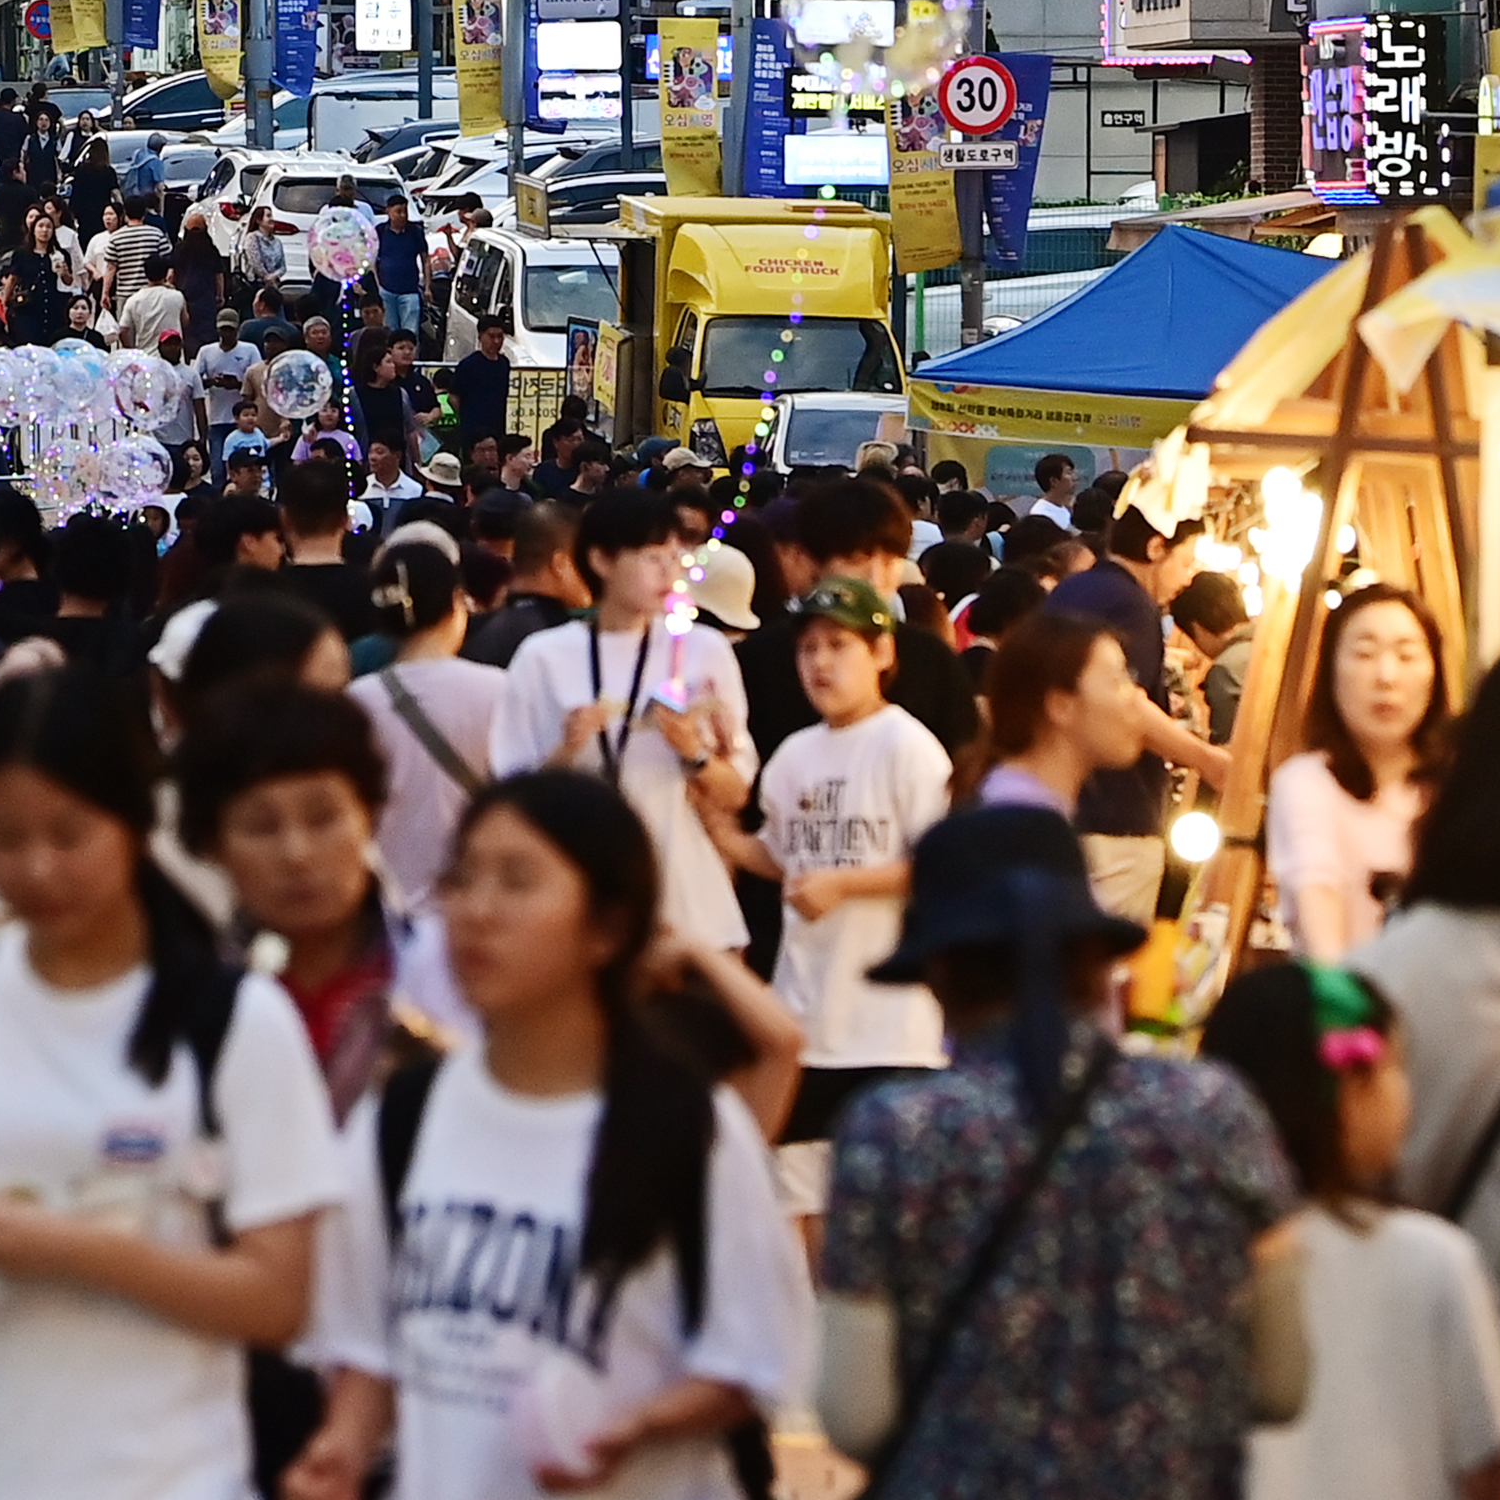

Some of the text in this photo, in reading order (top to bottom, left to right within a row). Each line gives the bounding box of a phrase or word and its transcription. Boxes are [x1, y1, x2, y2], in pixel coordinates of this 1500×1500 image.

[956, 77, 998, 113] 30
[1376, 29, 1428, 178] 노래방
[1103, 112, 1145, 126] 흡연구역
[942, 147, 1014, 163] 생활도로구역
[892, 157, 939, 174] 오십시
[744, 265, 840, 276] FOOD TRUCK
[758, 258, 824, 268] CHICKEN
